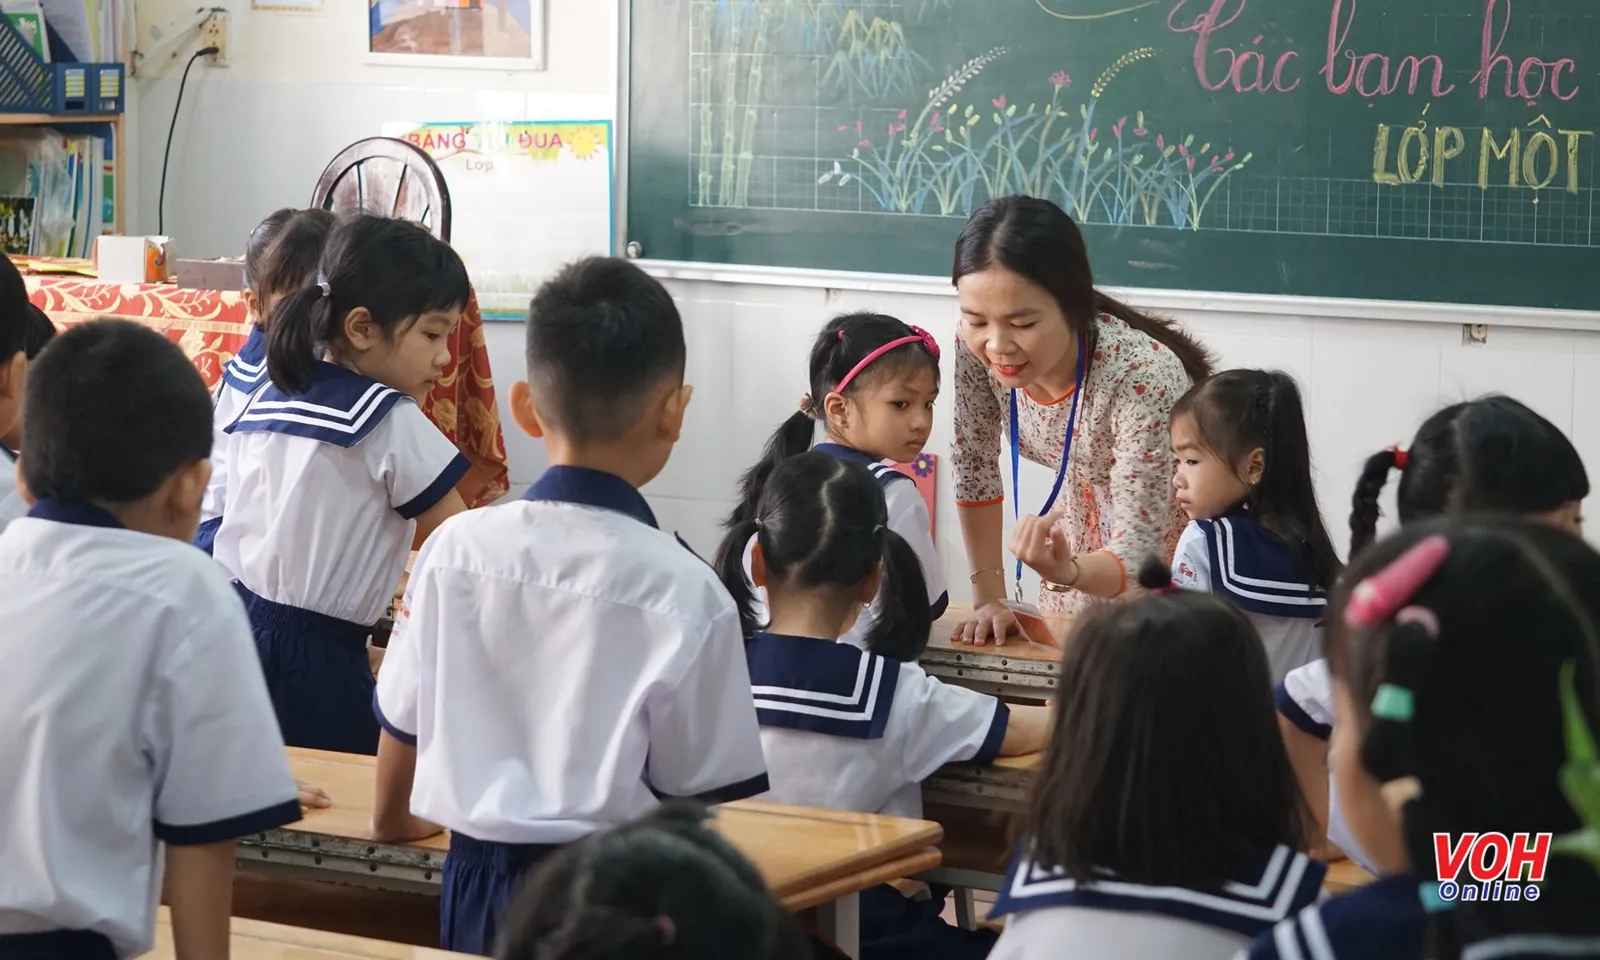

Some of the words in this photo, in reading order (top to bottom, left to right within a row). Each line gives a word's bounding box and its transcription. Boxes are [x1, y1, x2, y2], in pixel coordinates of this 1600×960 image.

[1168, 0, 1301, 94] Các
[1319, 0, 1455, 108] bạn
[1470, 0, 1580, 107] học
[518, 132, 564, 149] ĐUA
[1373, 102, 1465, 188] LỚP
[1478, 113, 1594, 205] MỘT
